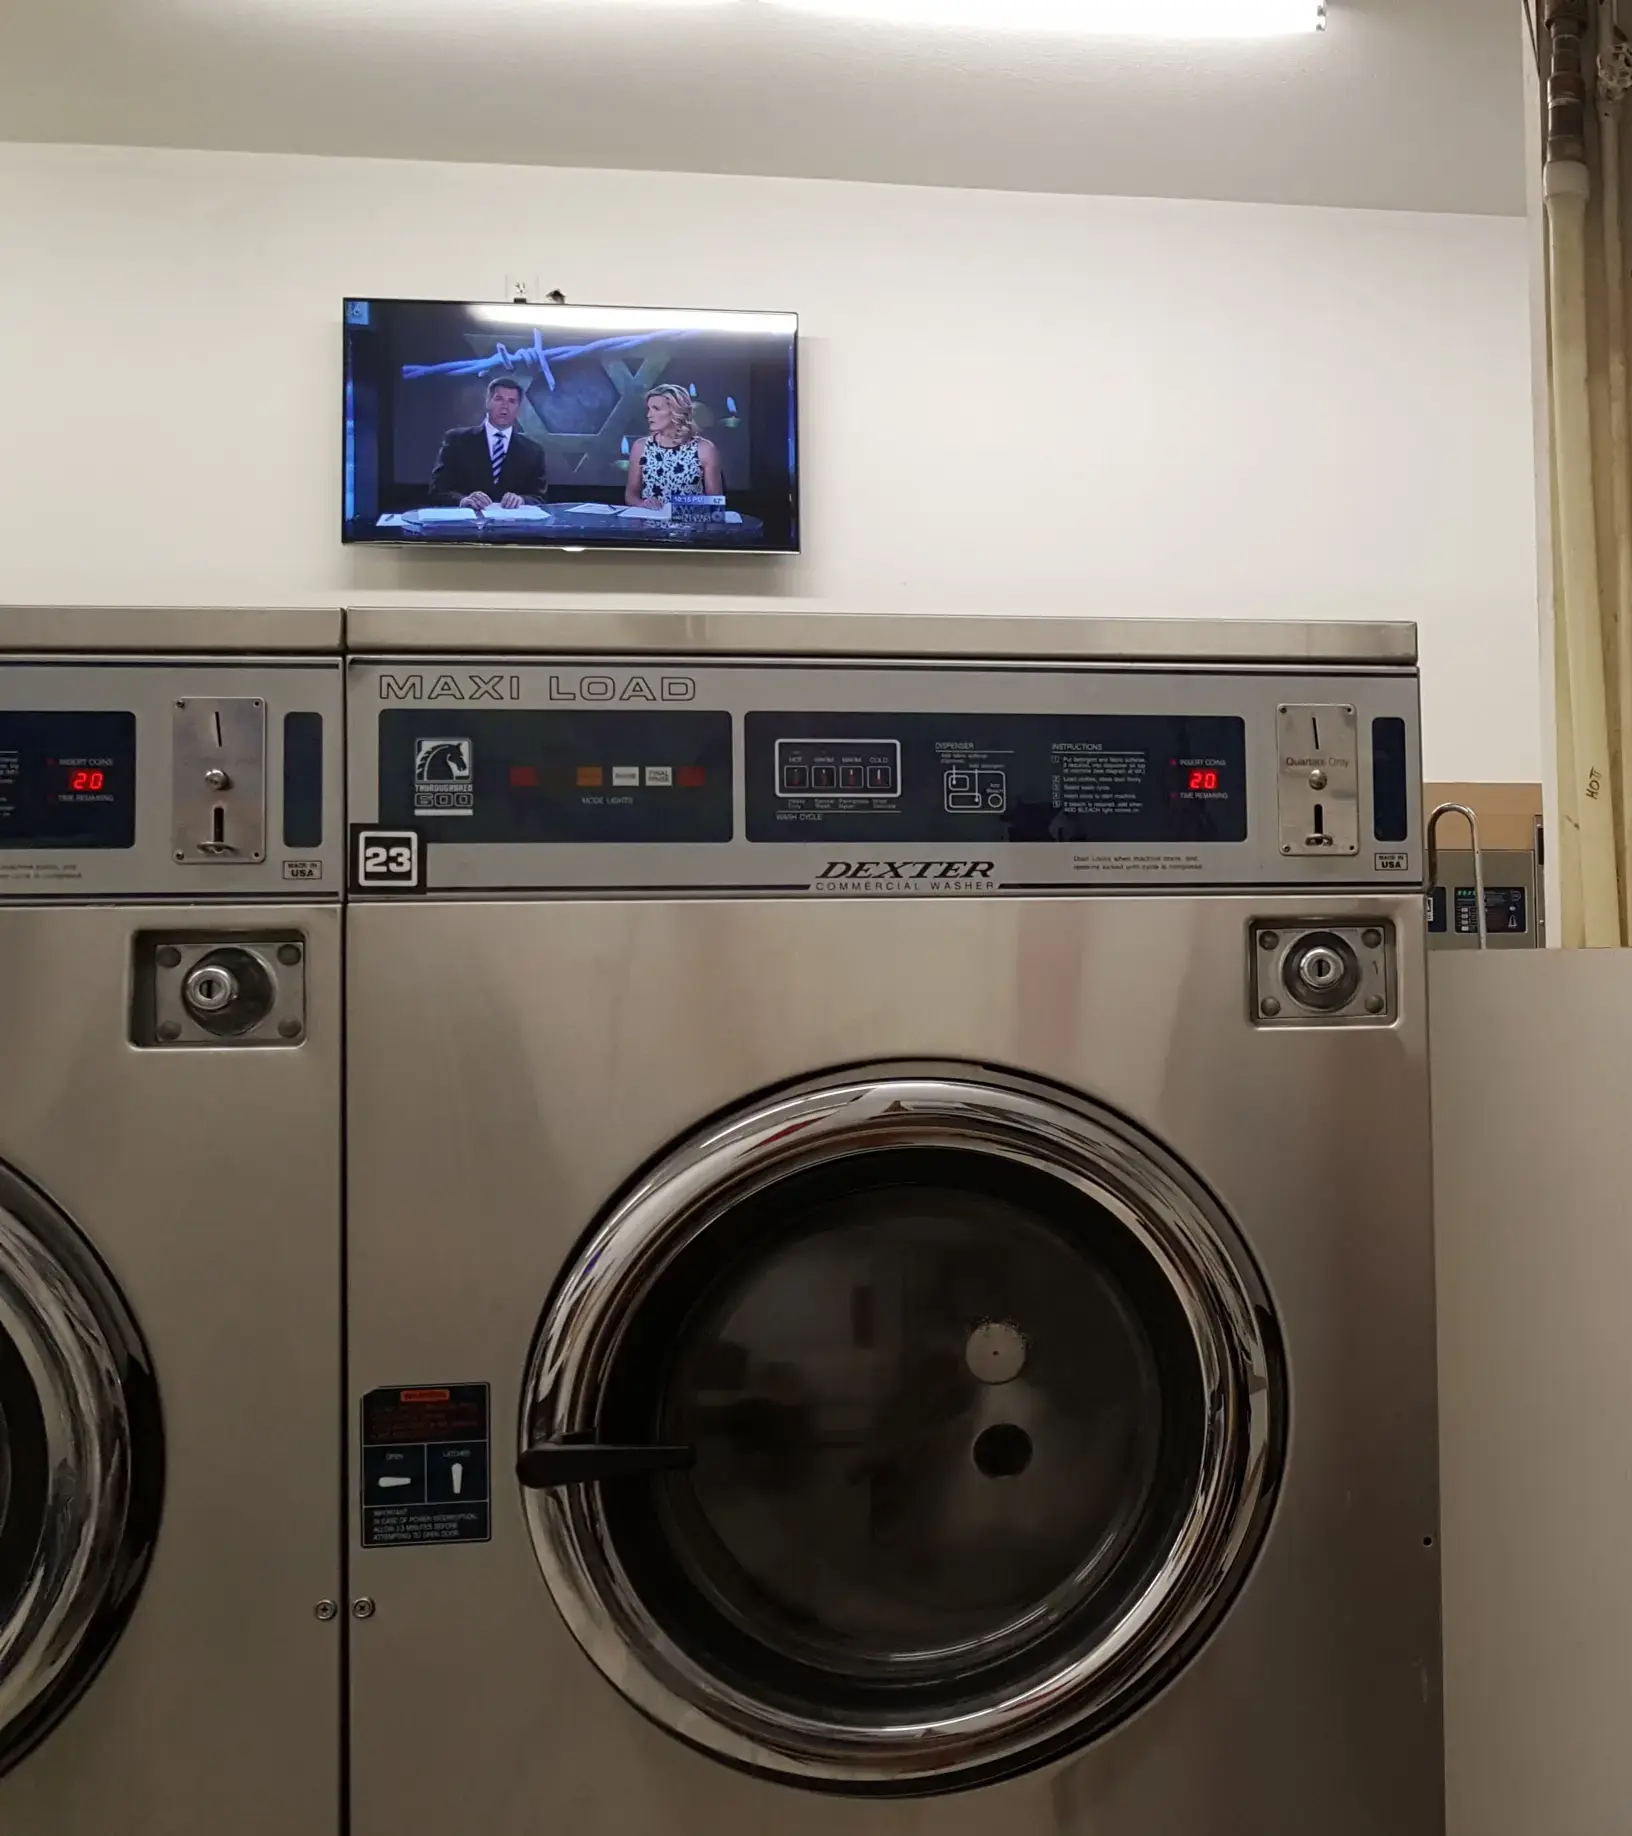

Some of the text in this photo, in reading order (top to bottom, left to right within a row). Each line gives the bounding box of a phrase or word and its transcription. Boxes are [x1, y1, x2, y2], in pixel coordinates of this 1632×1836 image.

[379, 674, 696, 702] MAXI LOAD
[935, 742, 974, 750] DISPENSER
[1051, 743, 1103, 751] INSTRUCTIONS
[88, 758, 113, 766] COINS
[869, 756, 889, 764] COLD
[1328, 757, 1349, 768] Only
[73, 772, 103, 790] 20
[1190, 772, 1216, 789] 20
[415, 793, 473, 807] 600
[364, 847, 412, 873] 23
[1381, 861, 1402, 869] USA
[291, 869, 314, 877] USA
[815, 861, 996, 879] DEXTER
[815, 881, 995, 891] COMMERCIAL WASHER
